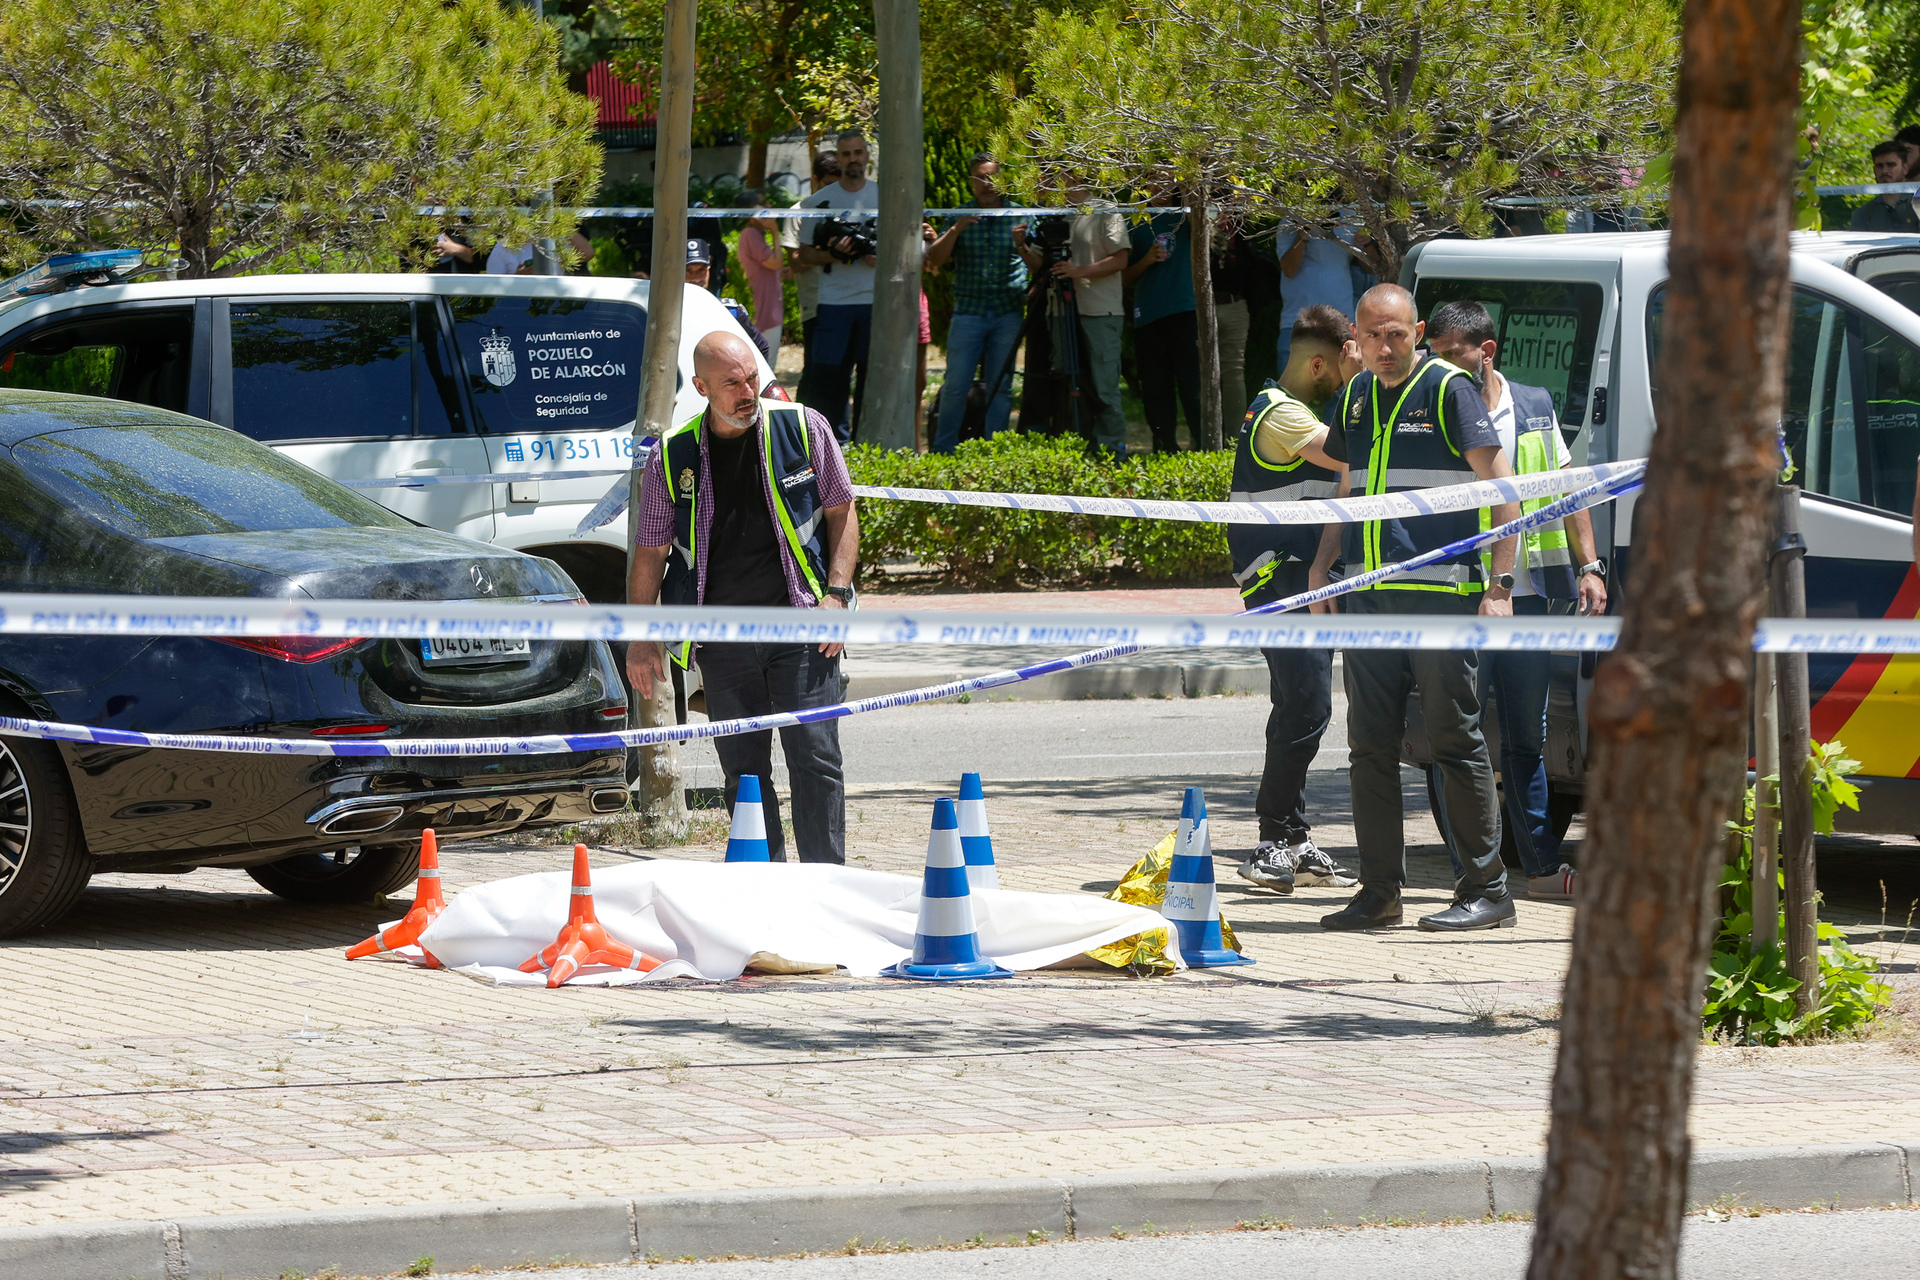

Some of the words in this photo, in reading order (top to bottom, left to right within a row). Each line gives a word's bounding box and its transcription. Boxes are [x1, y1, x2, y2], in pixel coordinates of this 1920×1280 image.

[525, 330, 602, 343] Ayuntamiento
[606, 329, 621, 339] de
[528, 346, 593, 362] POZUELO
[531, 366, 551, 380] DE
[554, 361, 626, 379] ALARCÓN
[535, 392, 591, 405] Concejalía
[594, 391, 608, 402] de
[536, 406, 589, 418] Seguridad
[531, 439, 555, 461] 91
[565, 438, 601, 460] 351
[648, 618, 727, 640] POLICÍA
[736, 622, 850, 641] MUNICIPAL
[940, 621, 1019, 643] POLICÍA
[1027, 626, 1139, 645] MUNICIPAL
[1226, 625, 1305, 646] POLICÍA
[1313, 629, 1423, 647] MUNICIPAL
